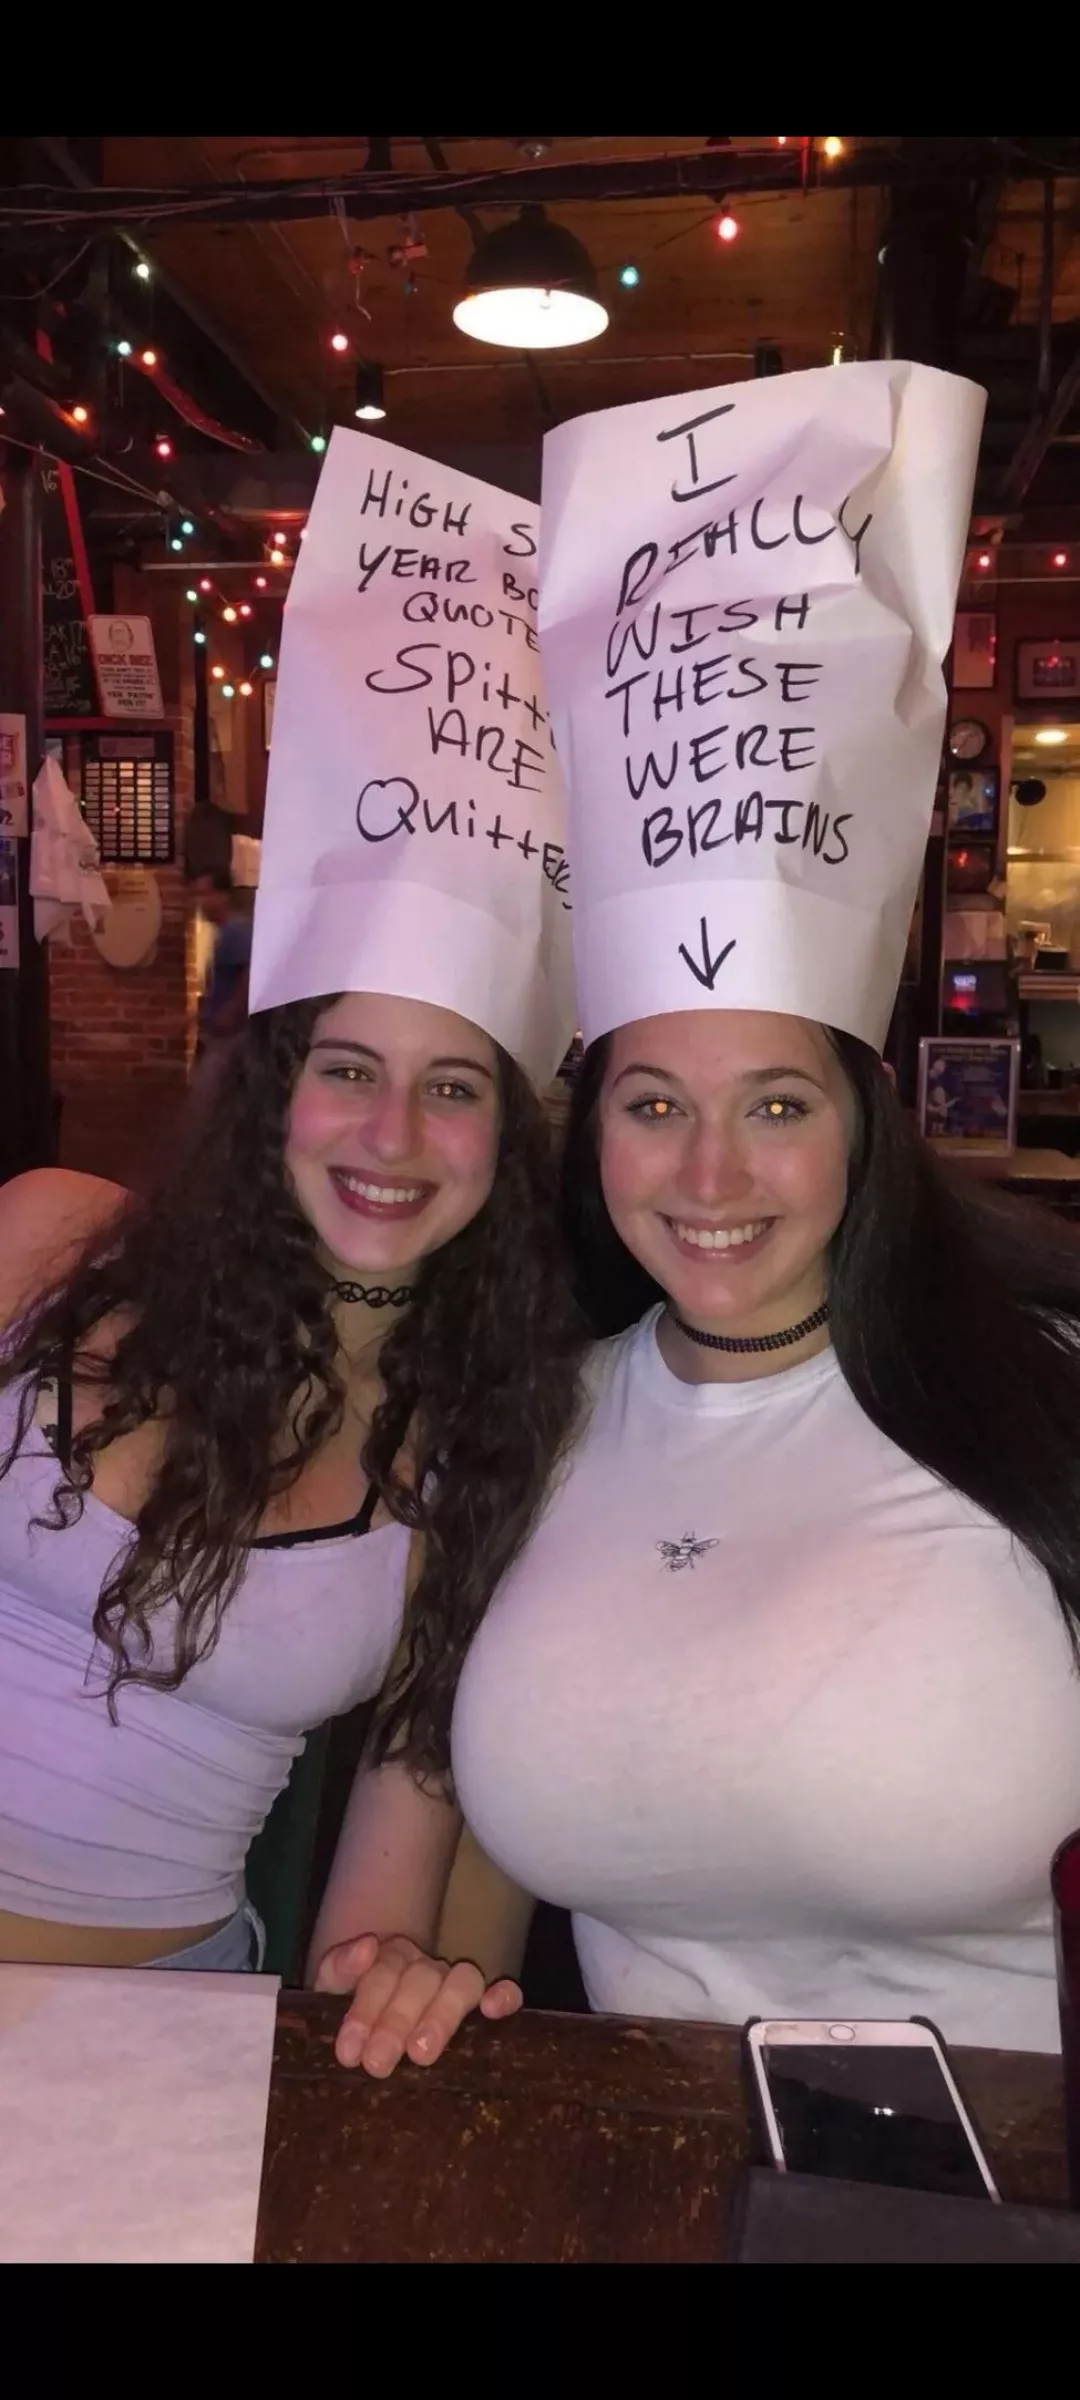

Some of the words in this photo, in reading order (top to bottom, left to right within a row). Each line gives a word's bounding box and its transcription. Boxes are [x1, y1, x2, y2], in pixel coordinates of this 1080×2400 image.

[656, 403, 738, 503] I
[356, 542, 478, 593] YEAR
[615, 494, 873, 617] REALLY
[606, 593, 811, 678] WISH
[605, 655, 824, 738] THESE
[427, 706, 547, 793] ARE
[625, 724, 817, 801] WERE
[641, 790, 855, 868] BRAINS
